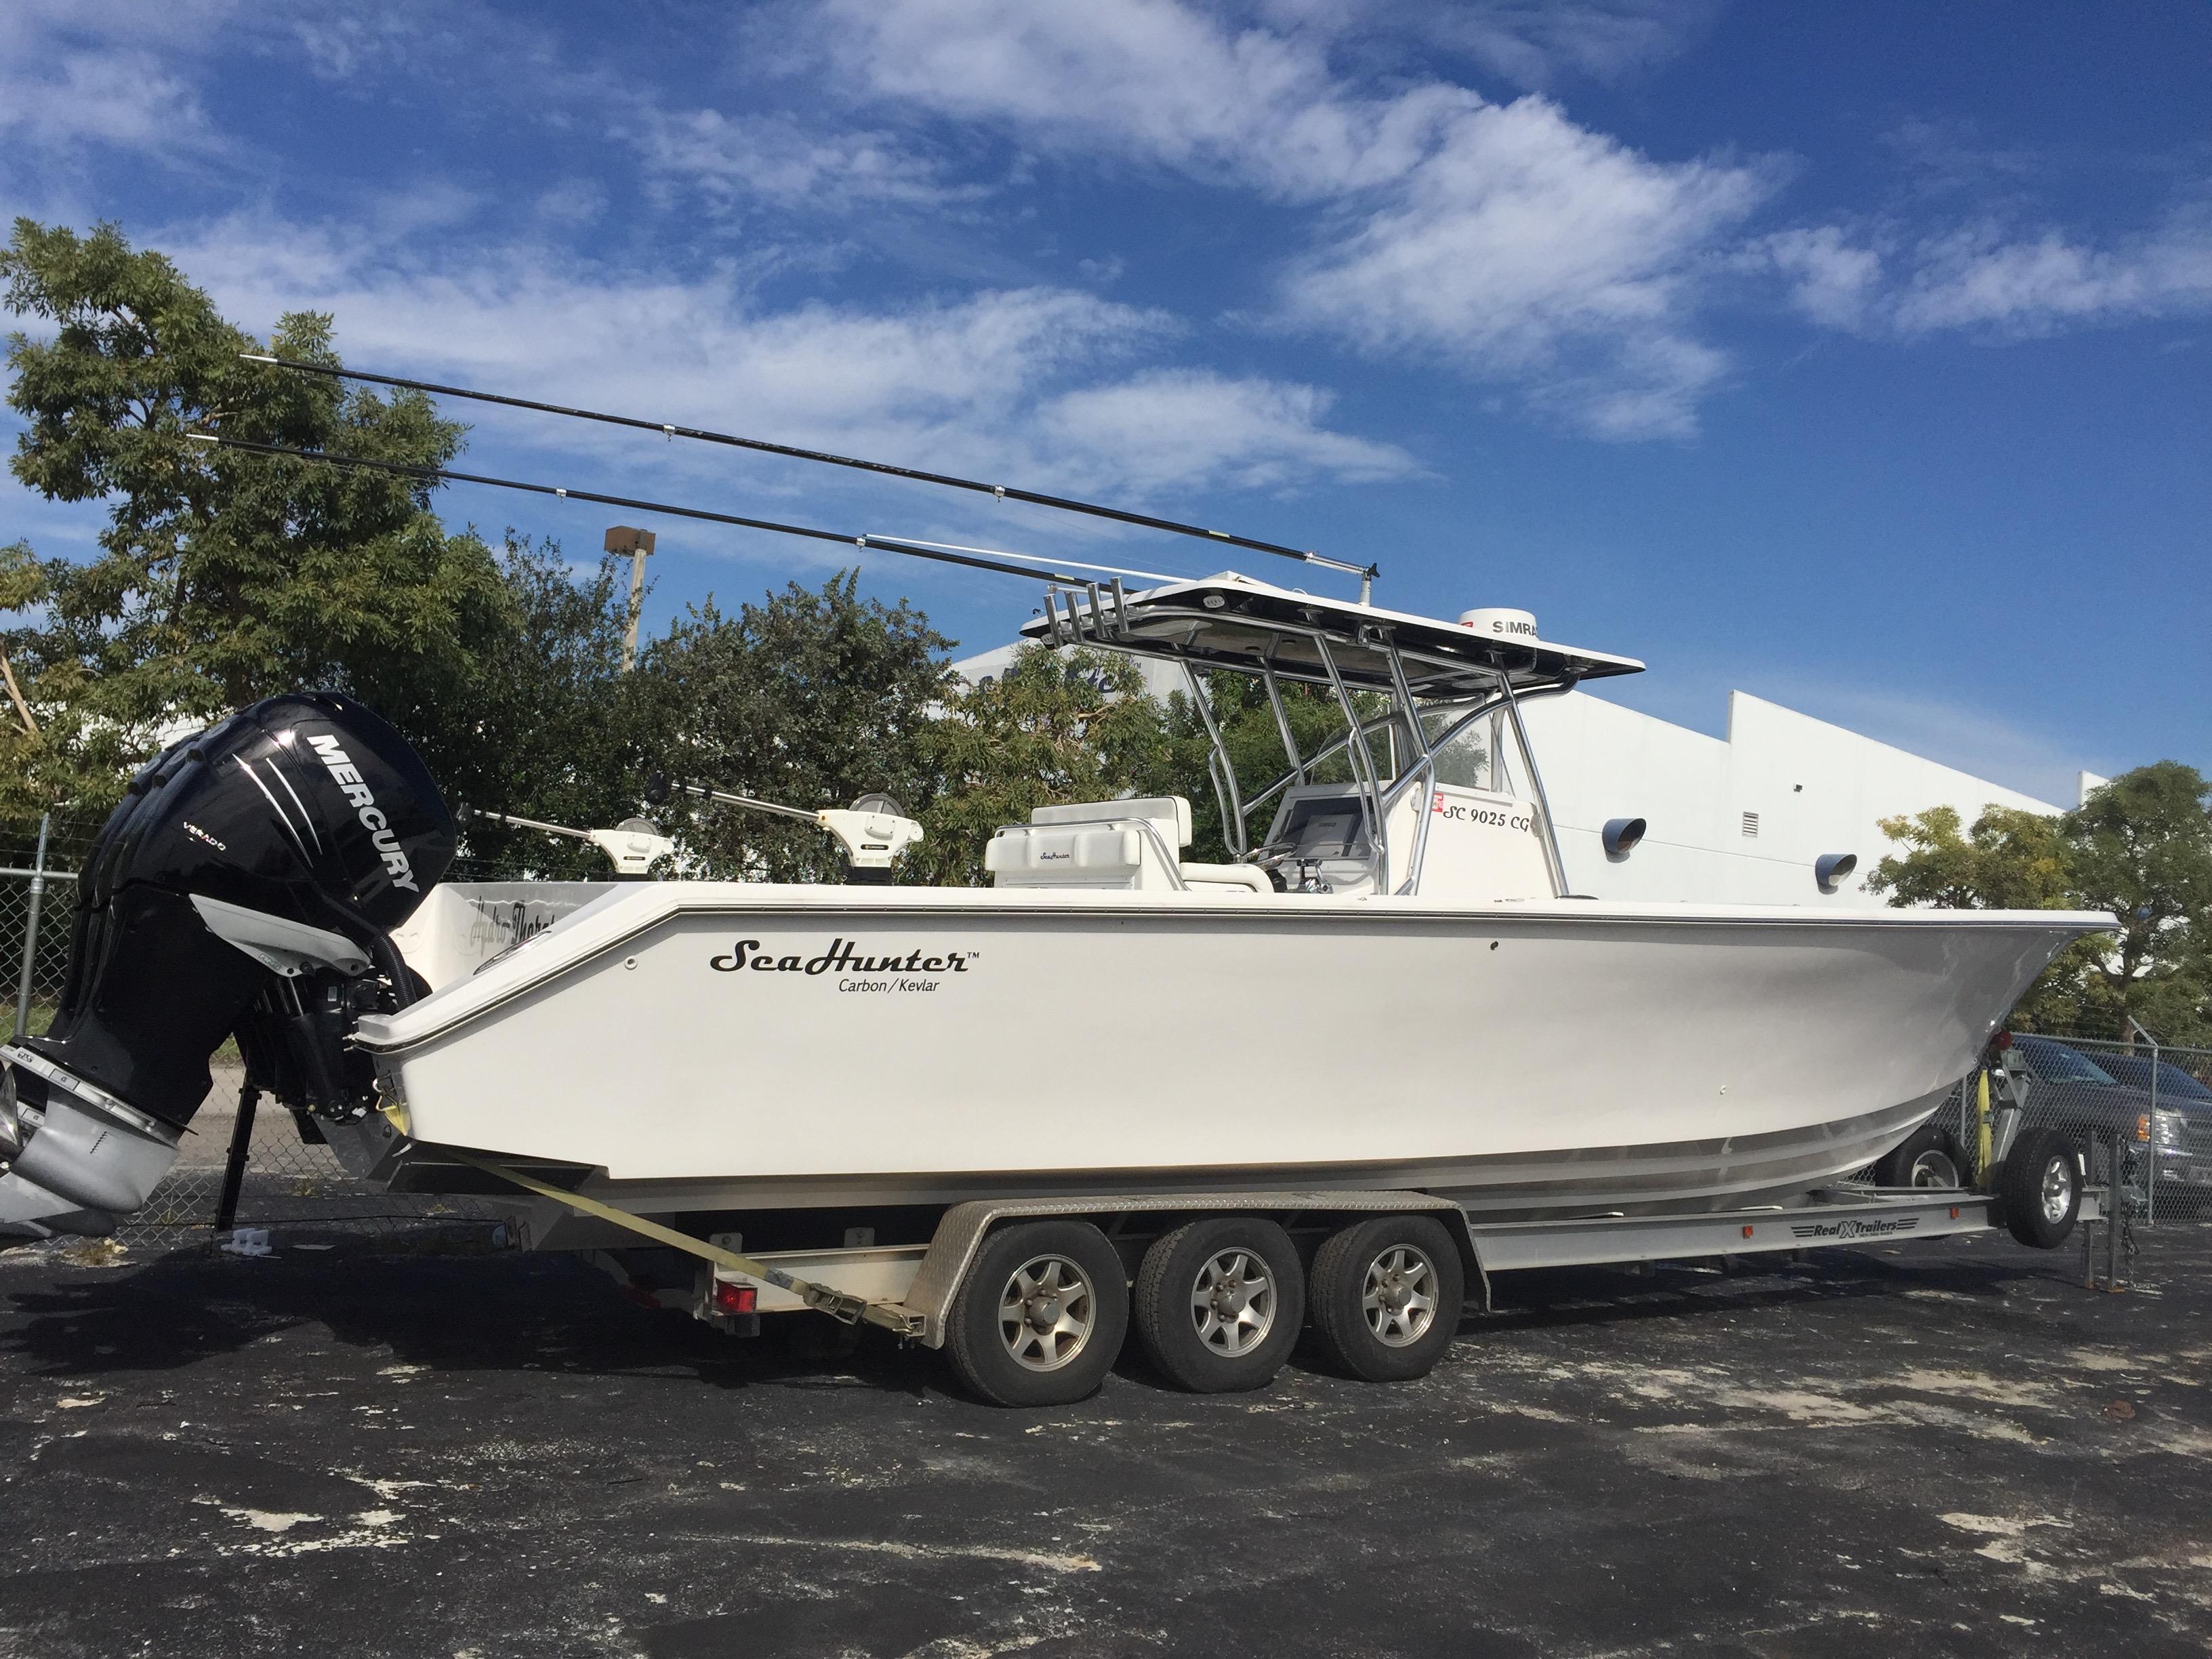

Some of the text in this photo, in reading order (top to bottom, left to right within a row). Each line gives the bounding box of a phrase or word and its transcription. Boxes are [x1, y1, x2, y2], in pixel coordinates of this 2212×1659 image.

[307, 734, 419, 893] MERCURY
[1443, 806, 1530, 833] SC 9025 CG
